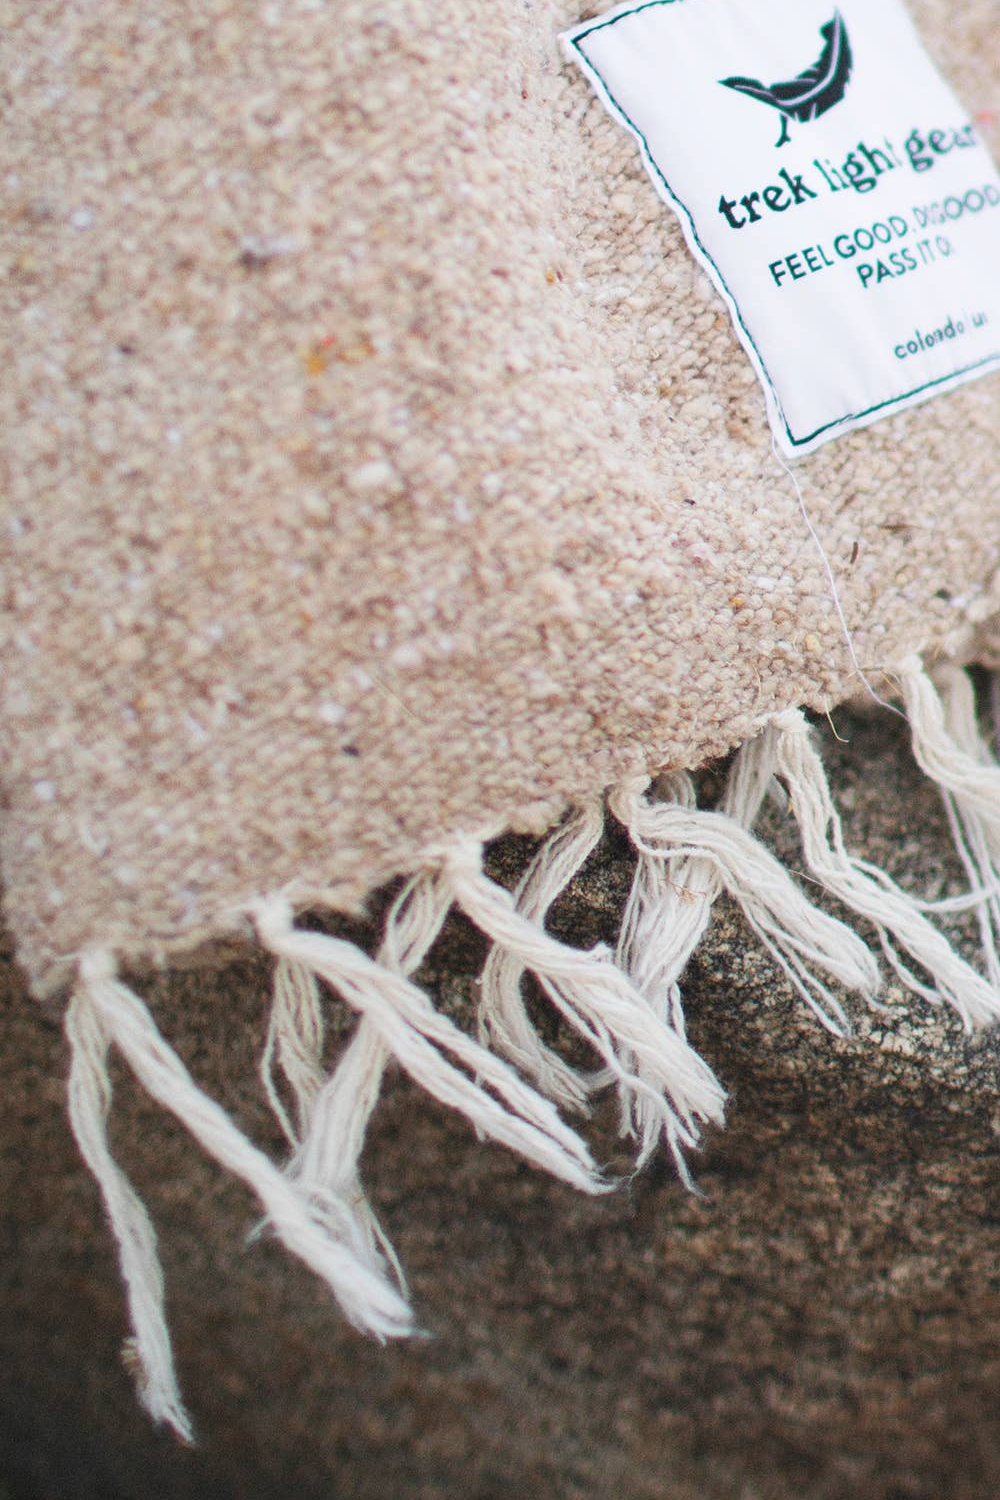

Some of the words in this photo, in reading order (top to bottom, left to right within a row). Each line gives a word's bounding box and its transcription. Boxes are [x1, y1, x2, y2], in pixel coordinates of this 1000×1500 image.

[718, 167, 817, 229] trek
[904, 125, 976, 173] gea
[768, 244, 835, 287] FEEL
[856, 248, 917, 288] PASS
[935, 235, 955, 257] O
